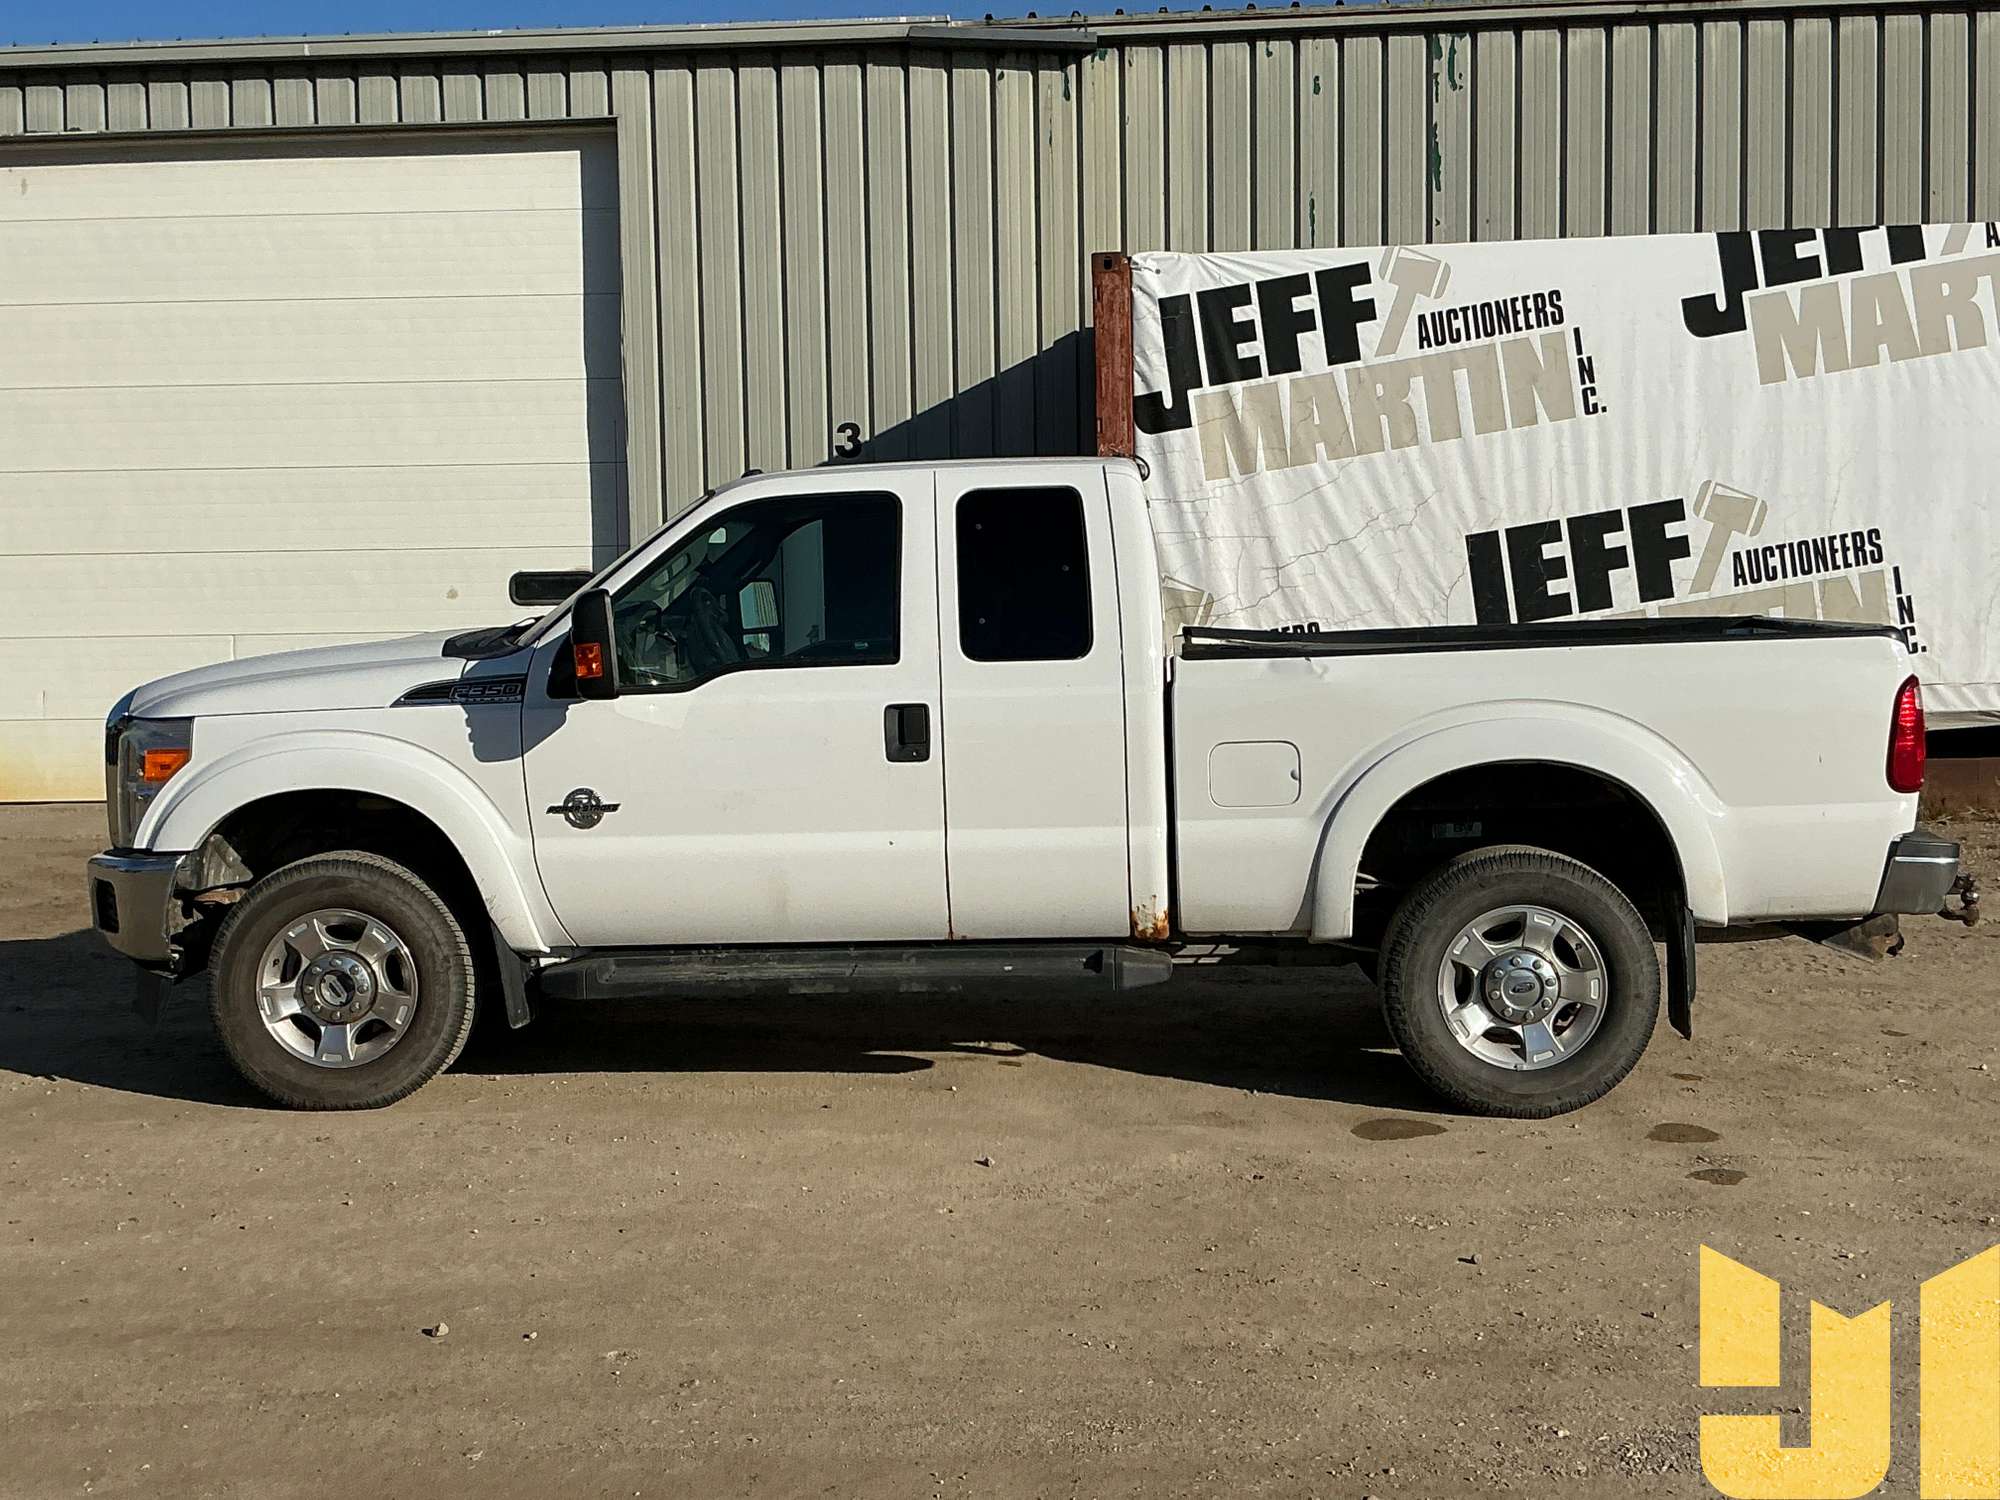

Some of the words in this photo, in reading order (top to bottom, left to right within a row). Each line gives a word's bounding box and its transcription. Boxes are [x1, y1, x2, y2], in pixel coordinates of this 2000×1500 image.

[1133, 262, 1377, 435] JEFF
[1417, 289, 1565, 349] AUCTIONEERS
[1194, 331, 1577, 481] MARTIN
[1573, 327, 1607, 415] INC.
[835, 422, 861, 458] 3
[1733, 528, 1884, 586] AUCTIONEERS
